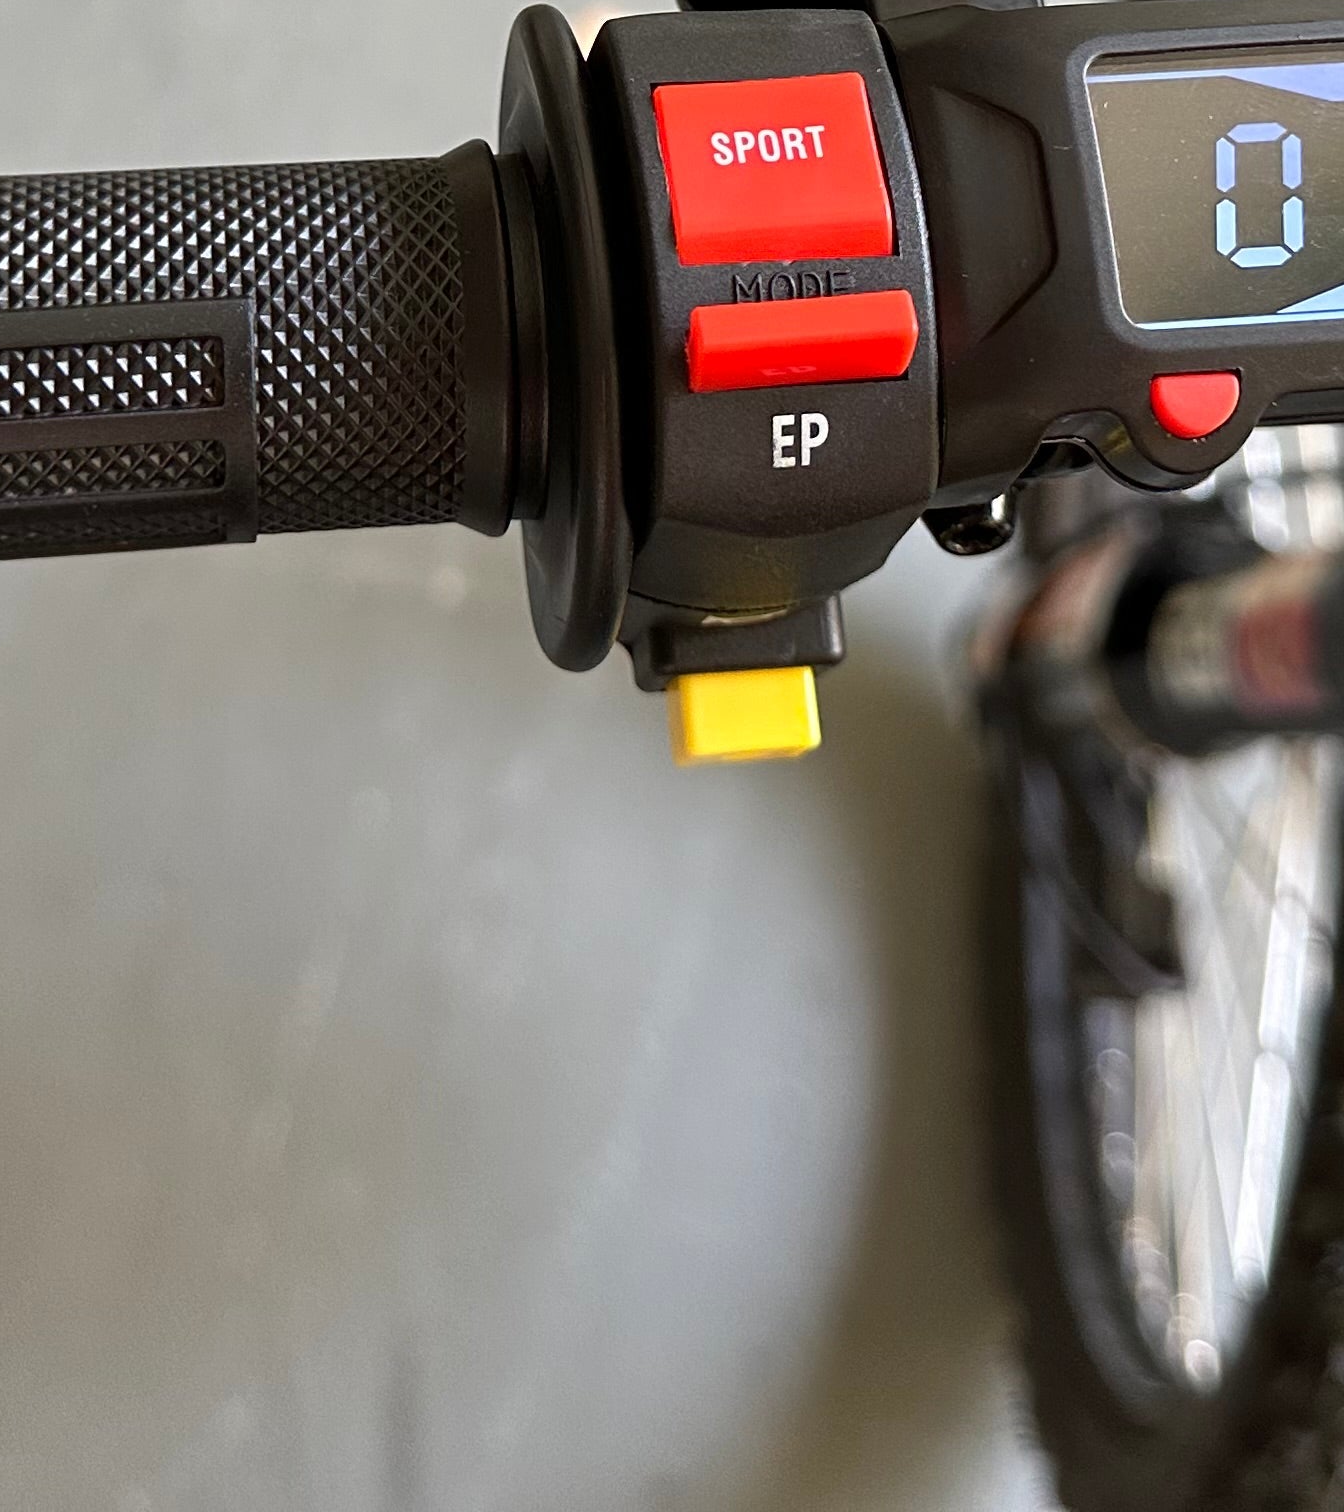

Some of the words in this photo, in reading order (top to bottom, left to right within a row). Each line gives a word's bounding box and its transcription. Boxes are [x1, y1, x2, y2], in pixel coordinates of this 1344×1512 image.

[710, 124, 825, 166] SPORT
[1215, 121, 1305, 269] 0
[772, 412, 829, 468] EP
